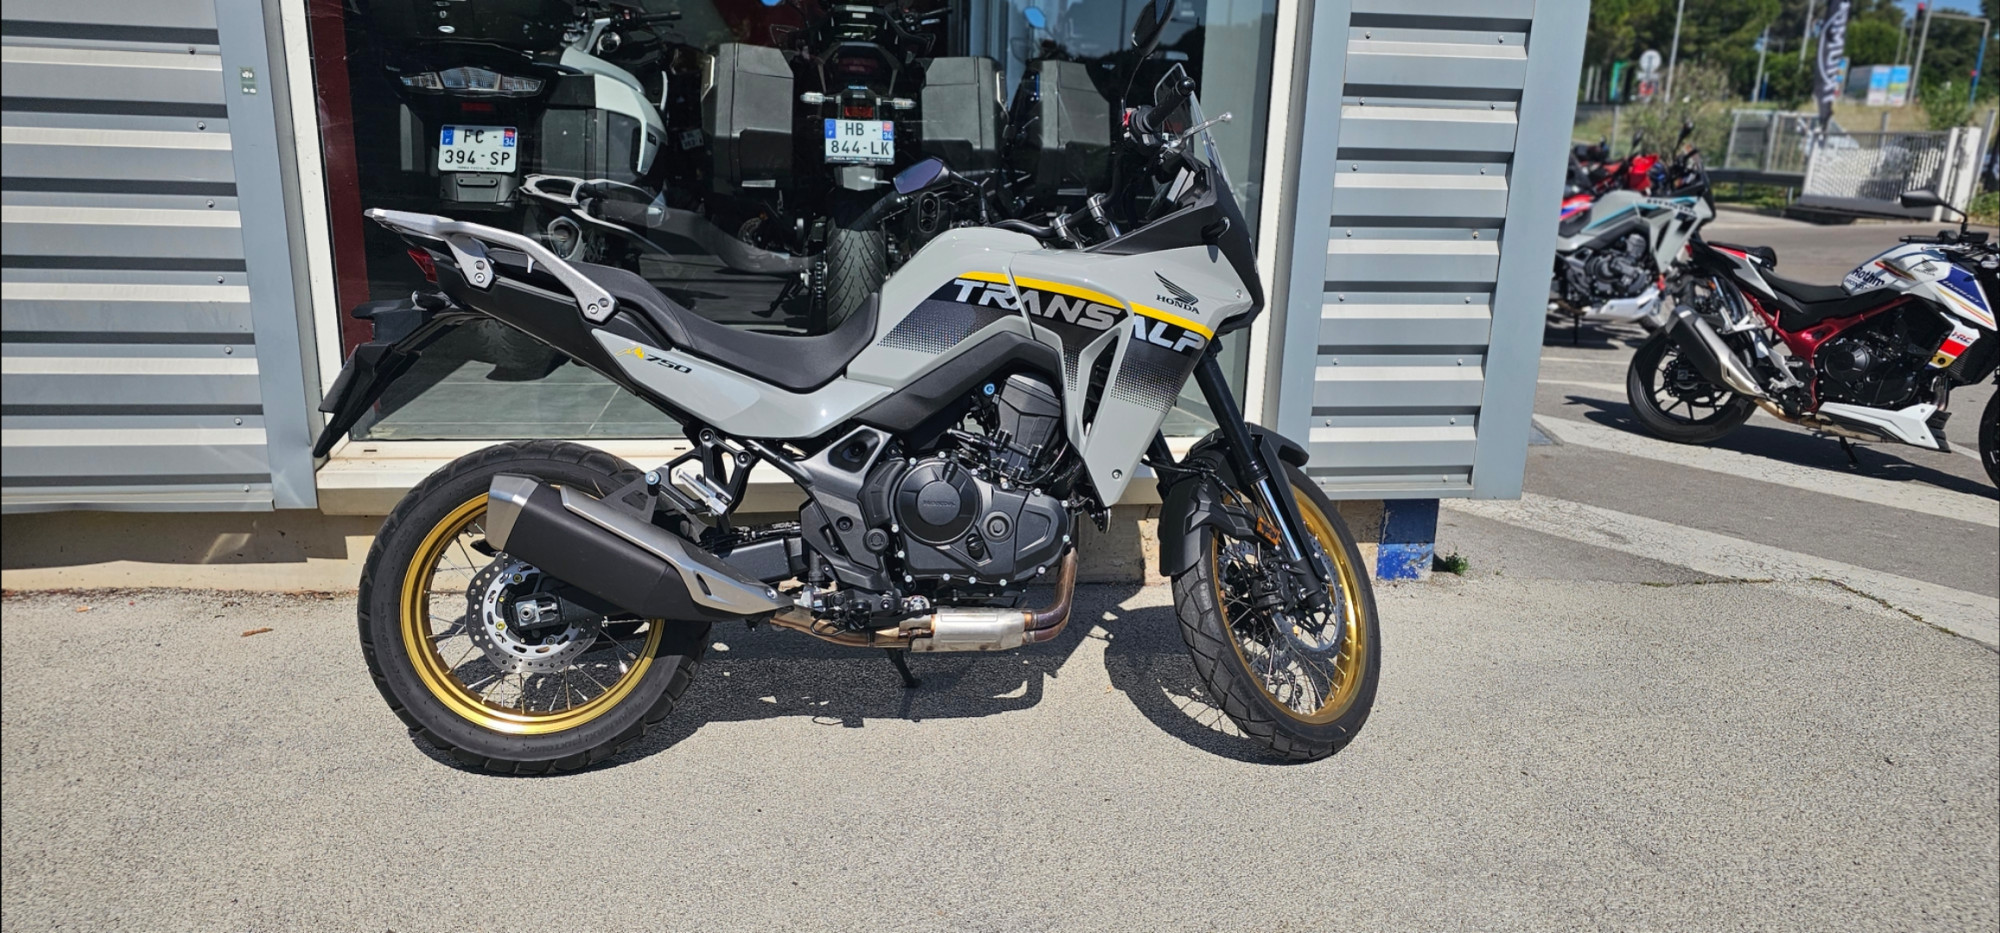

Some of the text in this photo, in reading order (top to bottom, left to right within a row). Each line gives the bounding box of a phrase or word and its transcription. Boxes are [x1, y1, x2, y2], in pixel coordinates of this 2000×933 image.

[463, 129, 485, 143] FC
[845, 122, 865, 136] HB
[883, 131, 893, 140] 34
[504, 137, 514, 146] 34
[831, 140, 889, 155] 844-LK
[444, 149, 511, 166] 394-SP
[1156, 294, 1200, 315] HONDA
[646, 353, 693, 374] 750
[922, 499, 957, 507] HONDA
